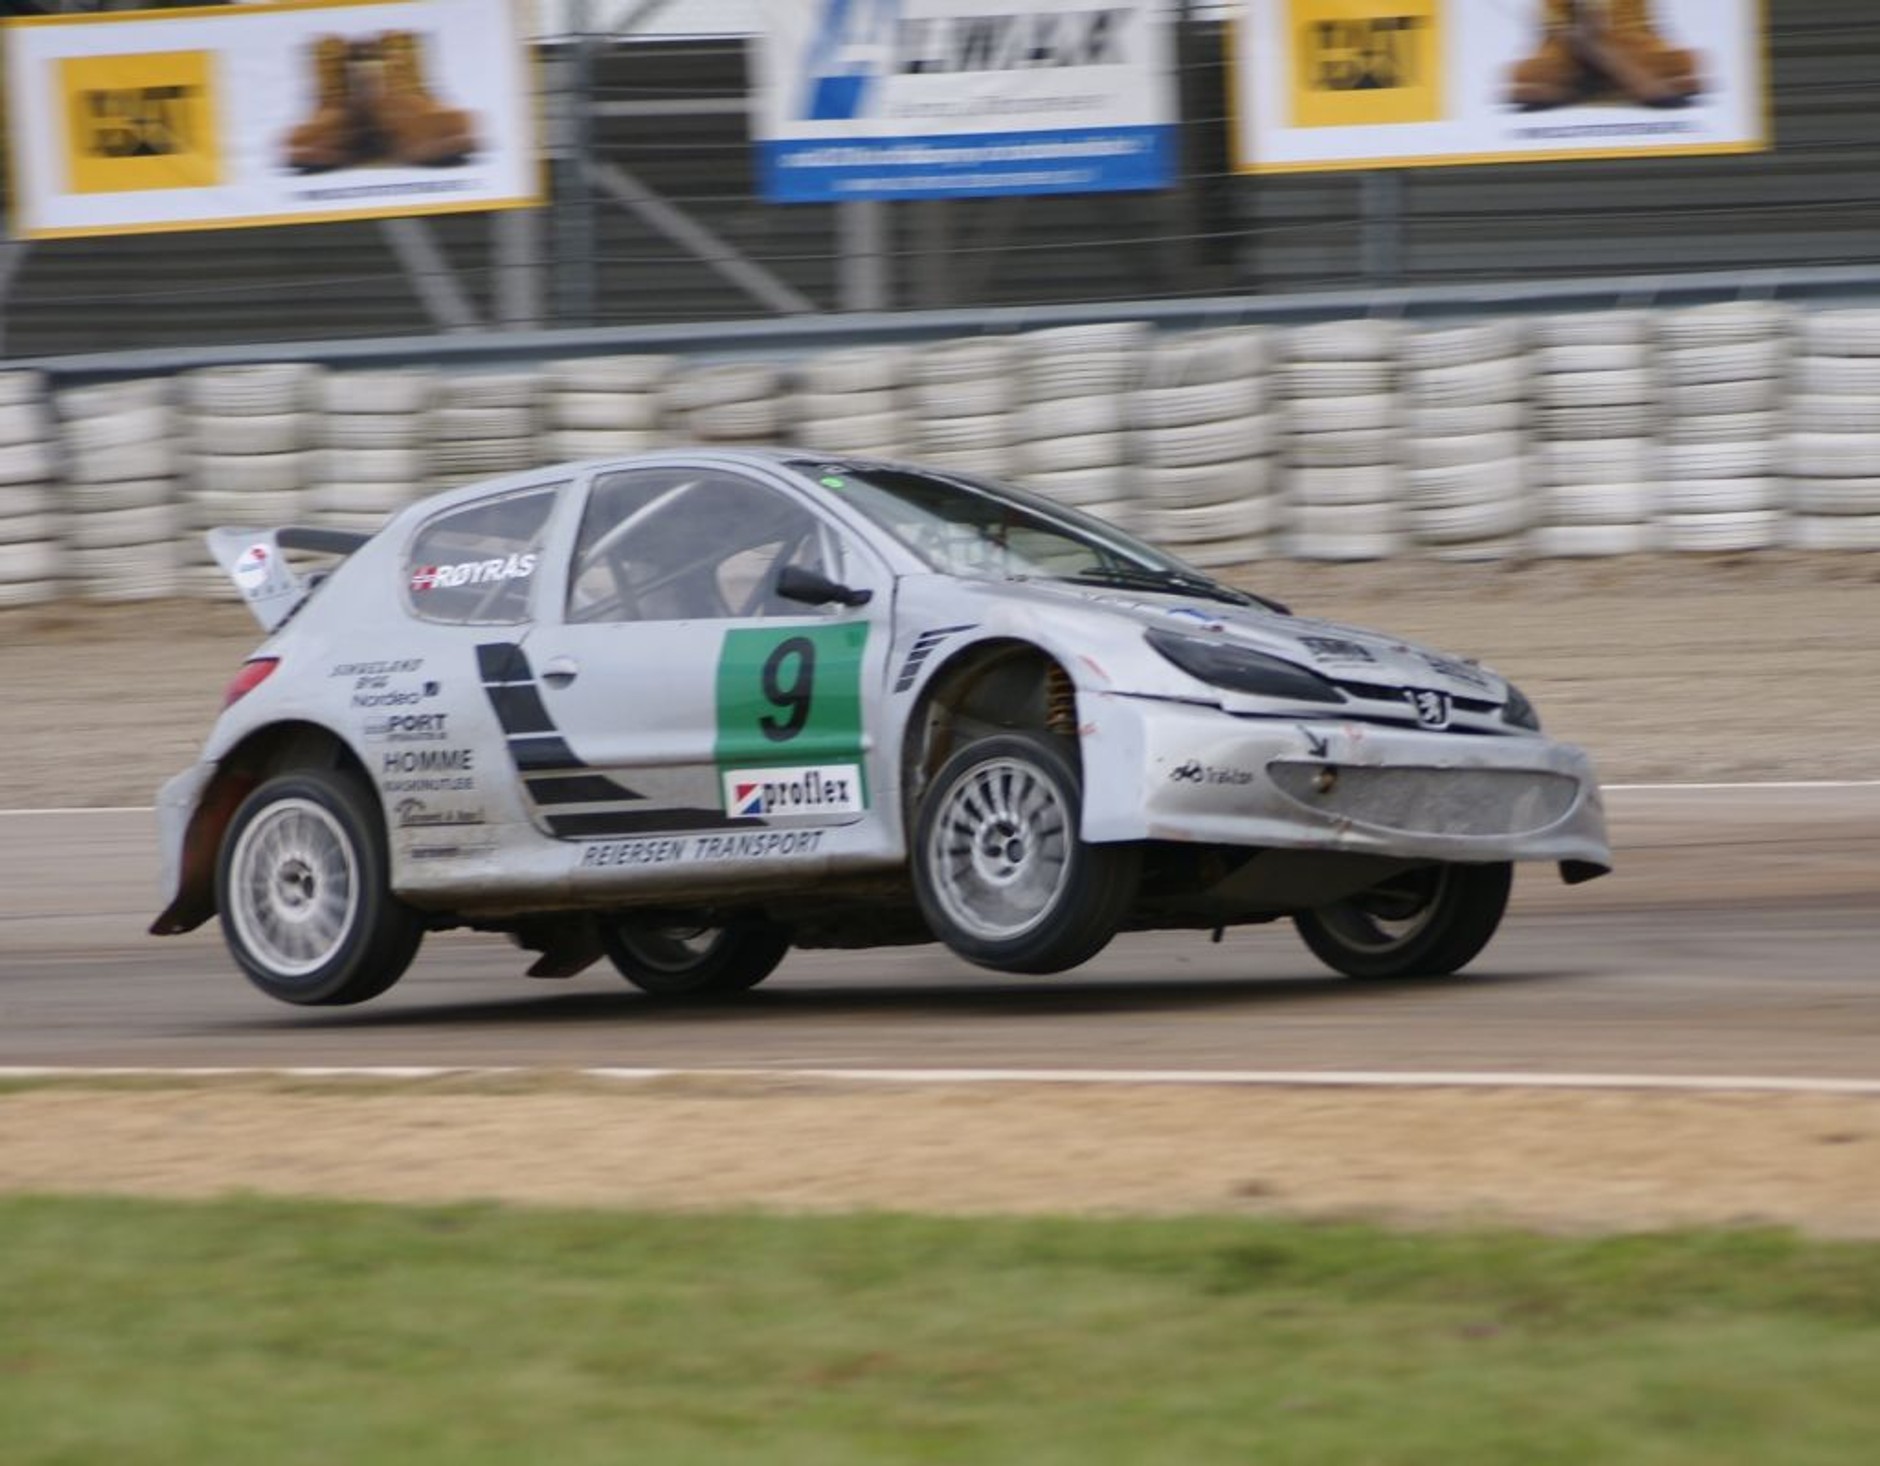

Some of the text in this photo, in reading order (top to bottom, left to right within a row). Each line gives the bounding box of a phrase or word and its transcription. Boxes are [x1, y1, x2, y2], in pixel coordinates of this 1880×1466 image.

[759, 636, 816, 742] 9
[387, 713, 447, 732] PORT
[383, 749, 474, 773] HOMME
[764, 771, 849, 813] proflex
[582, 831, 825, 867] REIERSEN TRANSPORT
